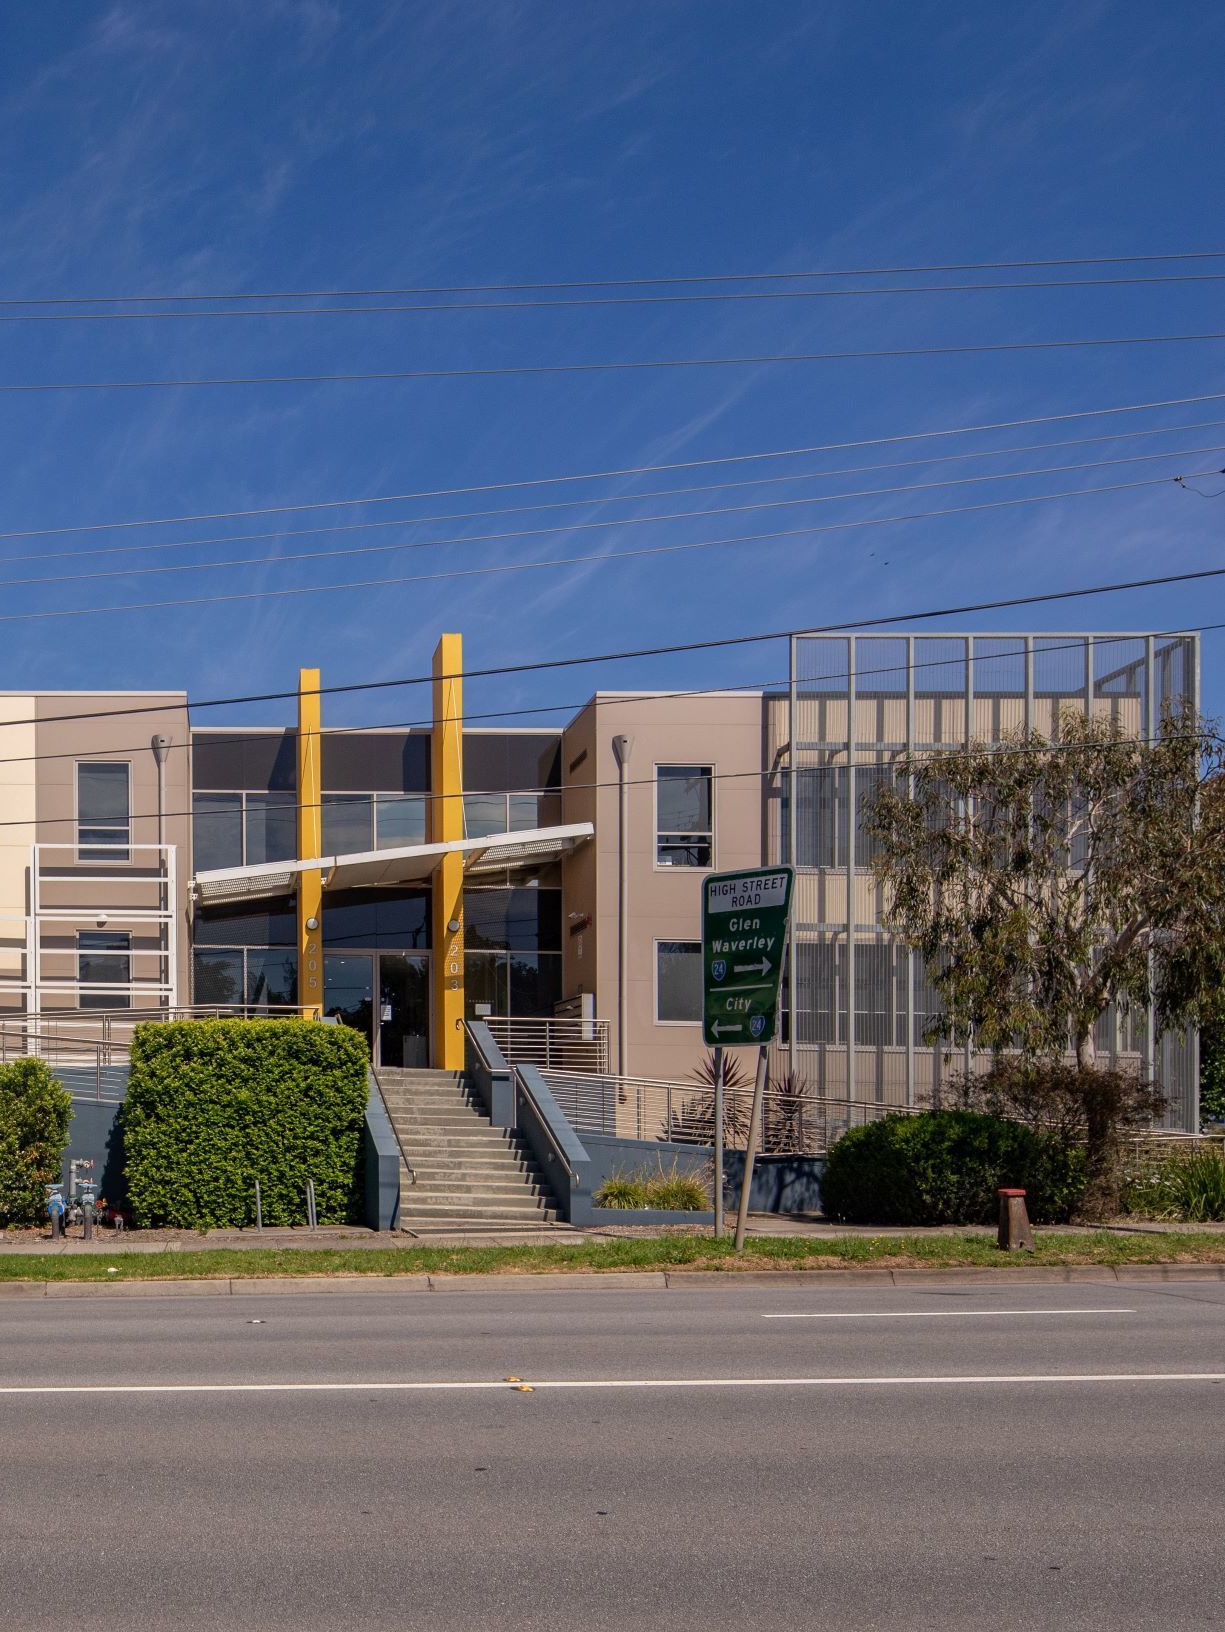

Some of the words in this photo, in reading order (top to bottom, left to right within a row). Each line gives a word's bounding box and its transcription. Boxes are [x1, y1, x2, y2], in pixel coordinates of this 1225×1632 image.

[710, 883, 736, 897] HIGH
[742, 876, 786, 893] STREET
[731, 893, 761, 907] ROAD
[729, 917, 760, 932] Glen
[712, 936, 775, 953] Waverley
[309, 943, 317, 988] 205
[450, 944, 459, 991] 203
[713, 963, 724, 975] 24
[726, 998, 752, 1012] City
[751, 1019, 762, 1032] 24
